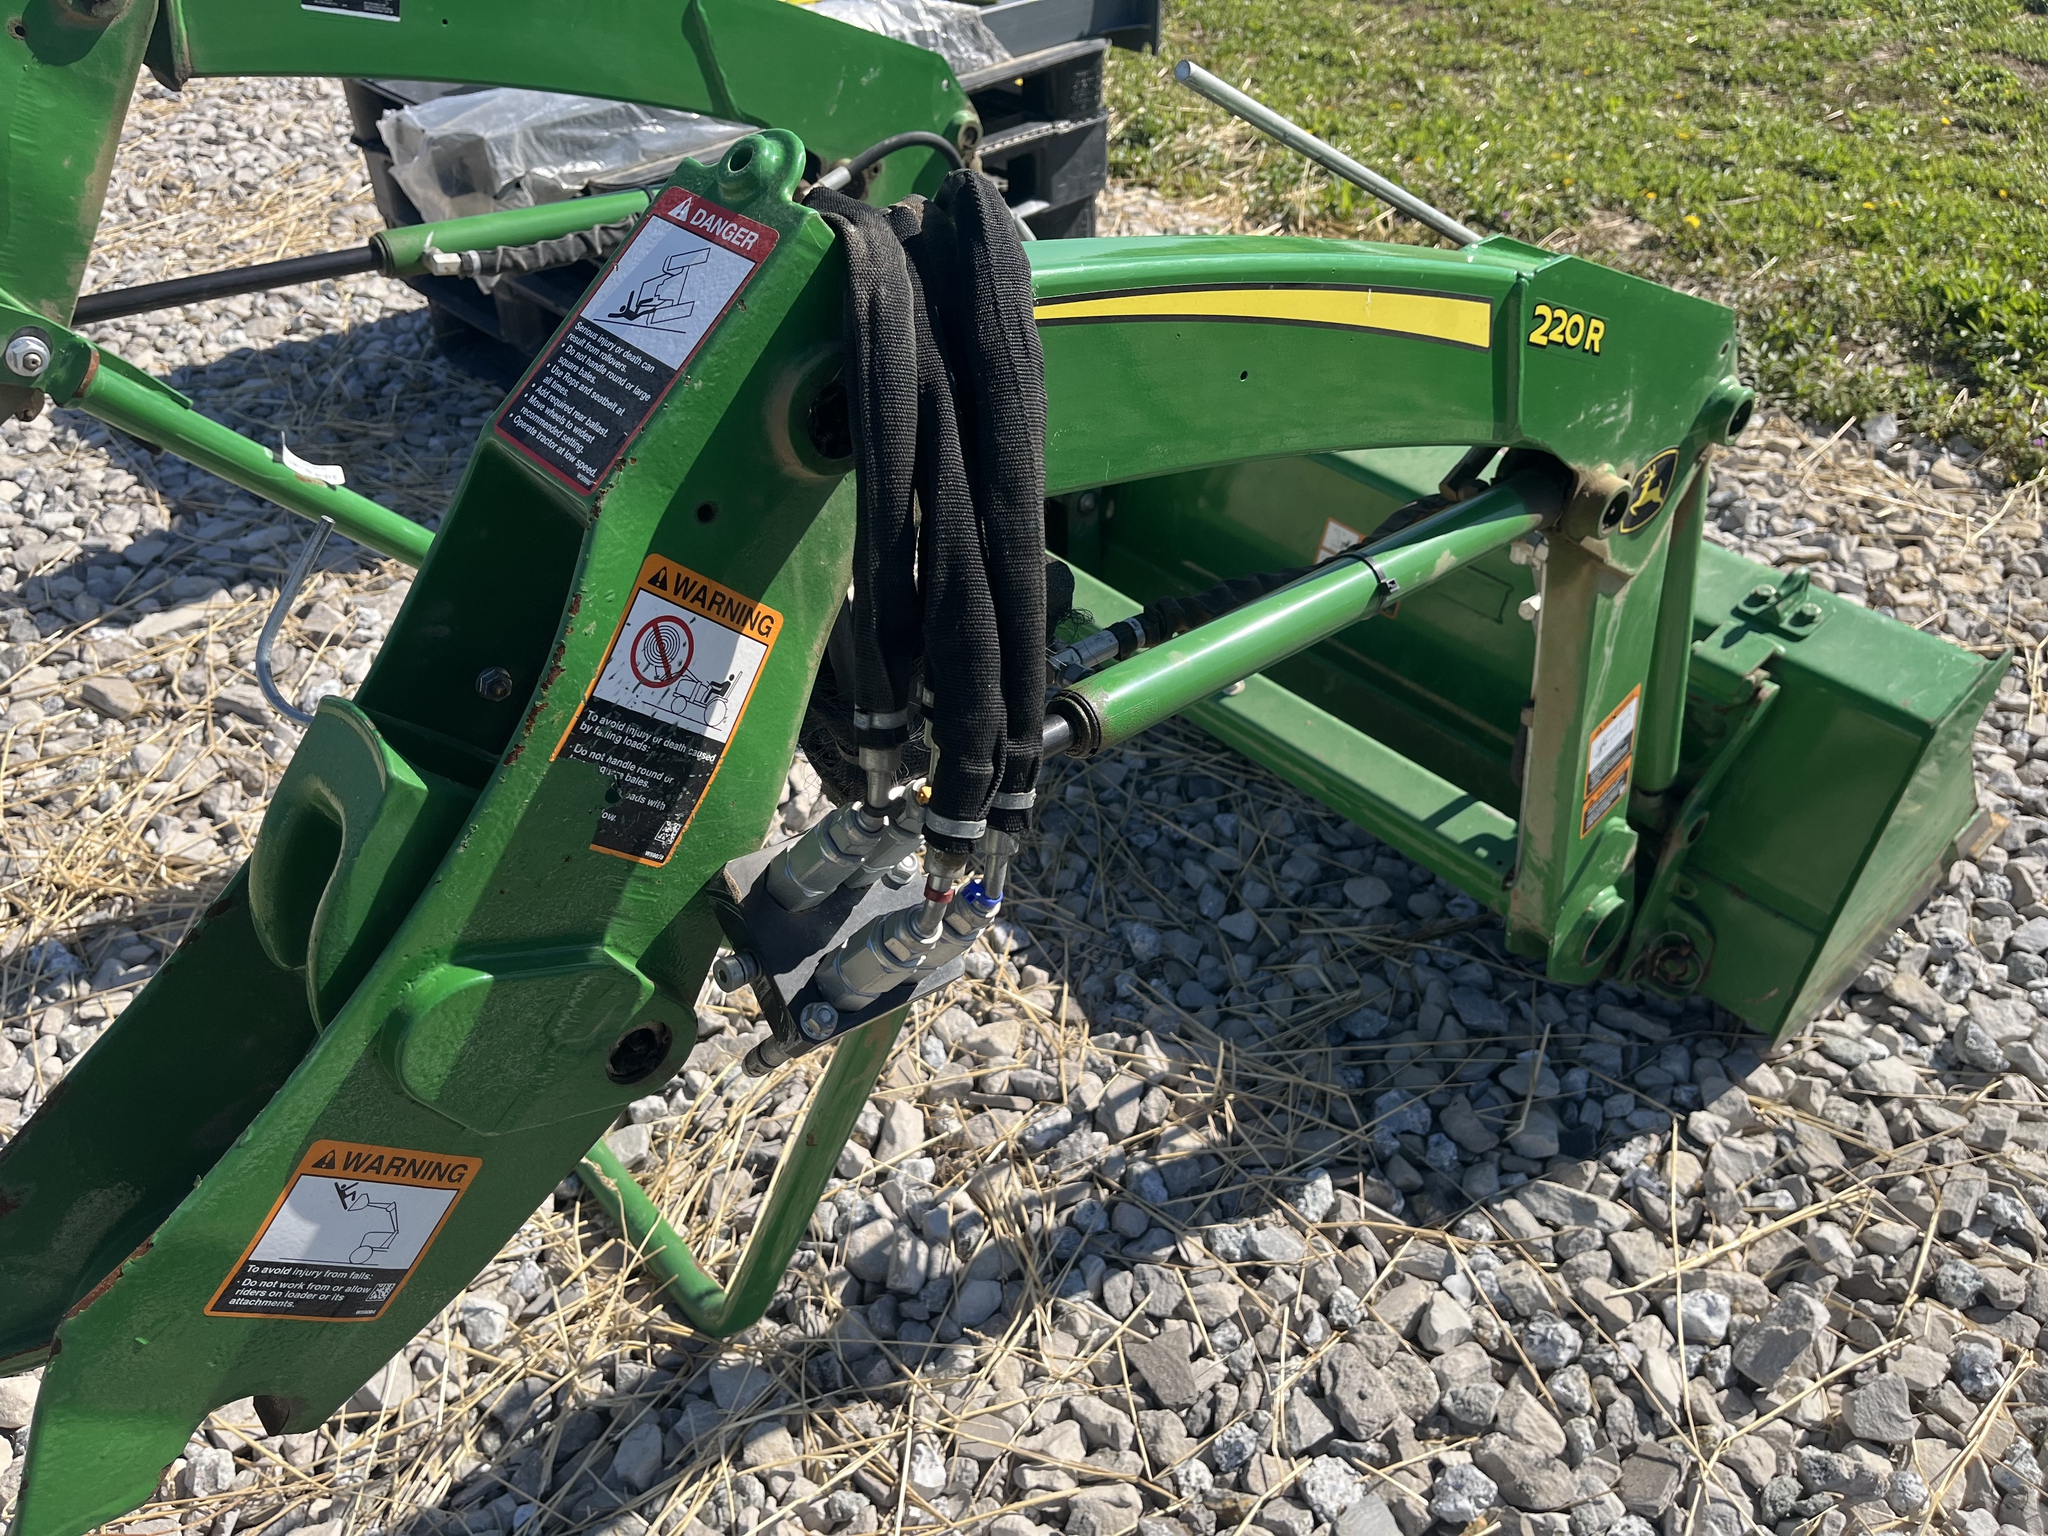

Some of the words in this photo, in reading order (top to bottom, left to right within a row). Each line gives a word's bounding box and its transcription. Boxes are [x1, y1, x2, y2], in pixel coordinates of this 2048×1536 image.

[690, 207, 760, 250] DANGER
[575, 321, 598, 340] Serious
[597, 334, 616, 351] injury
[615, 346, 623, 354] or
[623, 350, 642, 366] death
[641, 362, 655, 373] can
[1528, 303, 1605, 355] 220R
[558, 356, 579, 372] square
[578, 367, 596, 384] bales.
[567, 333, 586, 347] result
[584, 342, 600, 355] from
[599, 351, 628, 372] rollovers.
[543, 376, 553, 385] all
[551, 381, 568, 397] times.
[550, 365, 564, 377] Use
[563, 372, 579, 387] Rops
[578, 384, 593, 395] and
[591, 391, 618, 412] seatbelt
[616, 408, 625, 416] at
[565, 344, 576, 355] Do
[574, 353, 587, 363] not
[585, 357, 607, 374] handle
[606, 370, 627, 386] round
[625, 382, 634, 390] or
[633, 385, 651, 401] large
[520, 406, 564, 438] recommended
[561, 435, 584, 454] setting.
[528, 395, 545, 410] Move
[544, 407, 566, 425] wheels
[565, 420, 573, 429] to
[573, 425, 595, 444] widest
[535, 385, 550, 398] Add
[548, 394, 575, 414] required
[572, 411, 586, 423] rear
[585, 417, 609, 438] ballast.
[514, 415, 538, 436] Operate
[536, 431, 558, 449] tractor
[556, 446, 565, 455] at
[564, 450, 576, 462] low
[575, 460, 598, 477] speed.
[673, 572, 775, 638] WARNING
[580, 721, 592, 734] by
[623, 737, 651, 752] loads:
[588, 710, 598, 721] To
[599, 716, 626, 731] avoid
[626, 724, 652, 742] injury
[653, 736, 662, 744] or
[664, 739, 687, 752] death
[688, 748, 717, 762] caused
[574, 744, 588, 756] Do
[589, 751, 605, 761] not
[606, 755, 636, 771] handle
[636, 766, 664, 780] round
[664, 775, 674, 784] or
[625, 773, 650, 788] bales.
[601, 809, 617, 821] ow.
[647, 798, 666, 811] with
[342, 1151, 468, 1184] WARNING
[242, 1279, 257, 1287] Do
[259, 1280, 278, 1288] not
[279, 1281, 306, 1290] work
[306, 1282, 331, 1291] from
[344, 1285, 371, 1293] allow
[247, 1265, 259, 1273] To
[261, 1266, 292, 1275] avoid
[292, 1268, 322, 1279] injury
[324, 1270, 348, 1279] from
[349, 1272, 373, 1280] falls:
[229, 1297, 295, 1308] attachments.
[235, 1288, 266, 1297] riders
[284, 1291, 318, 1300] loader
